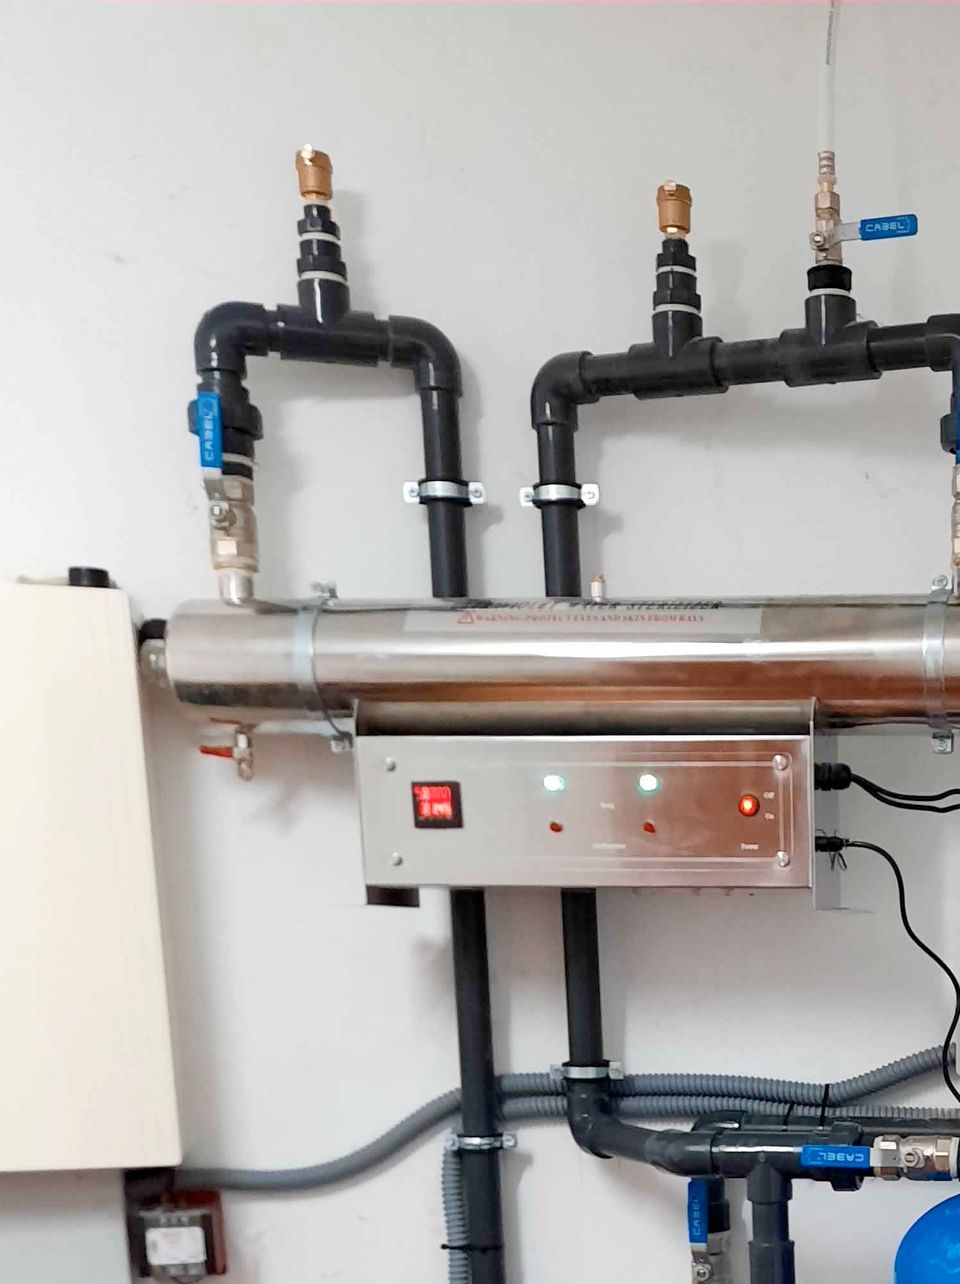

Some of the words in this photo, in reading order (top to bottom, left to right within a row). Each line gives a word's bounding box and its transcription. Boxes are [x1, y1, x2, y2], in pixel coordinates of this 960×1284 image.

[865, 221, 905, 232] CABEL
[203, 411, 214, 461] CABEL
[819, 1151, 865, 1162] CABEL
